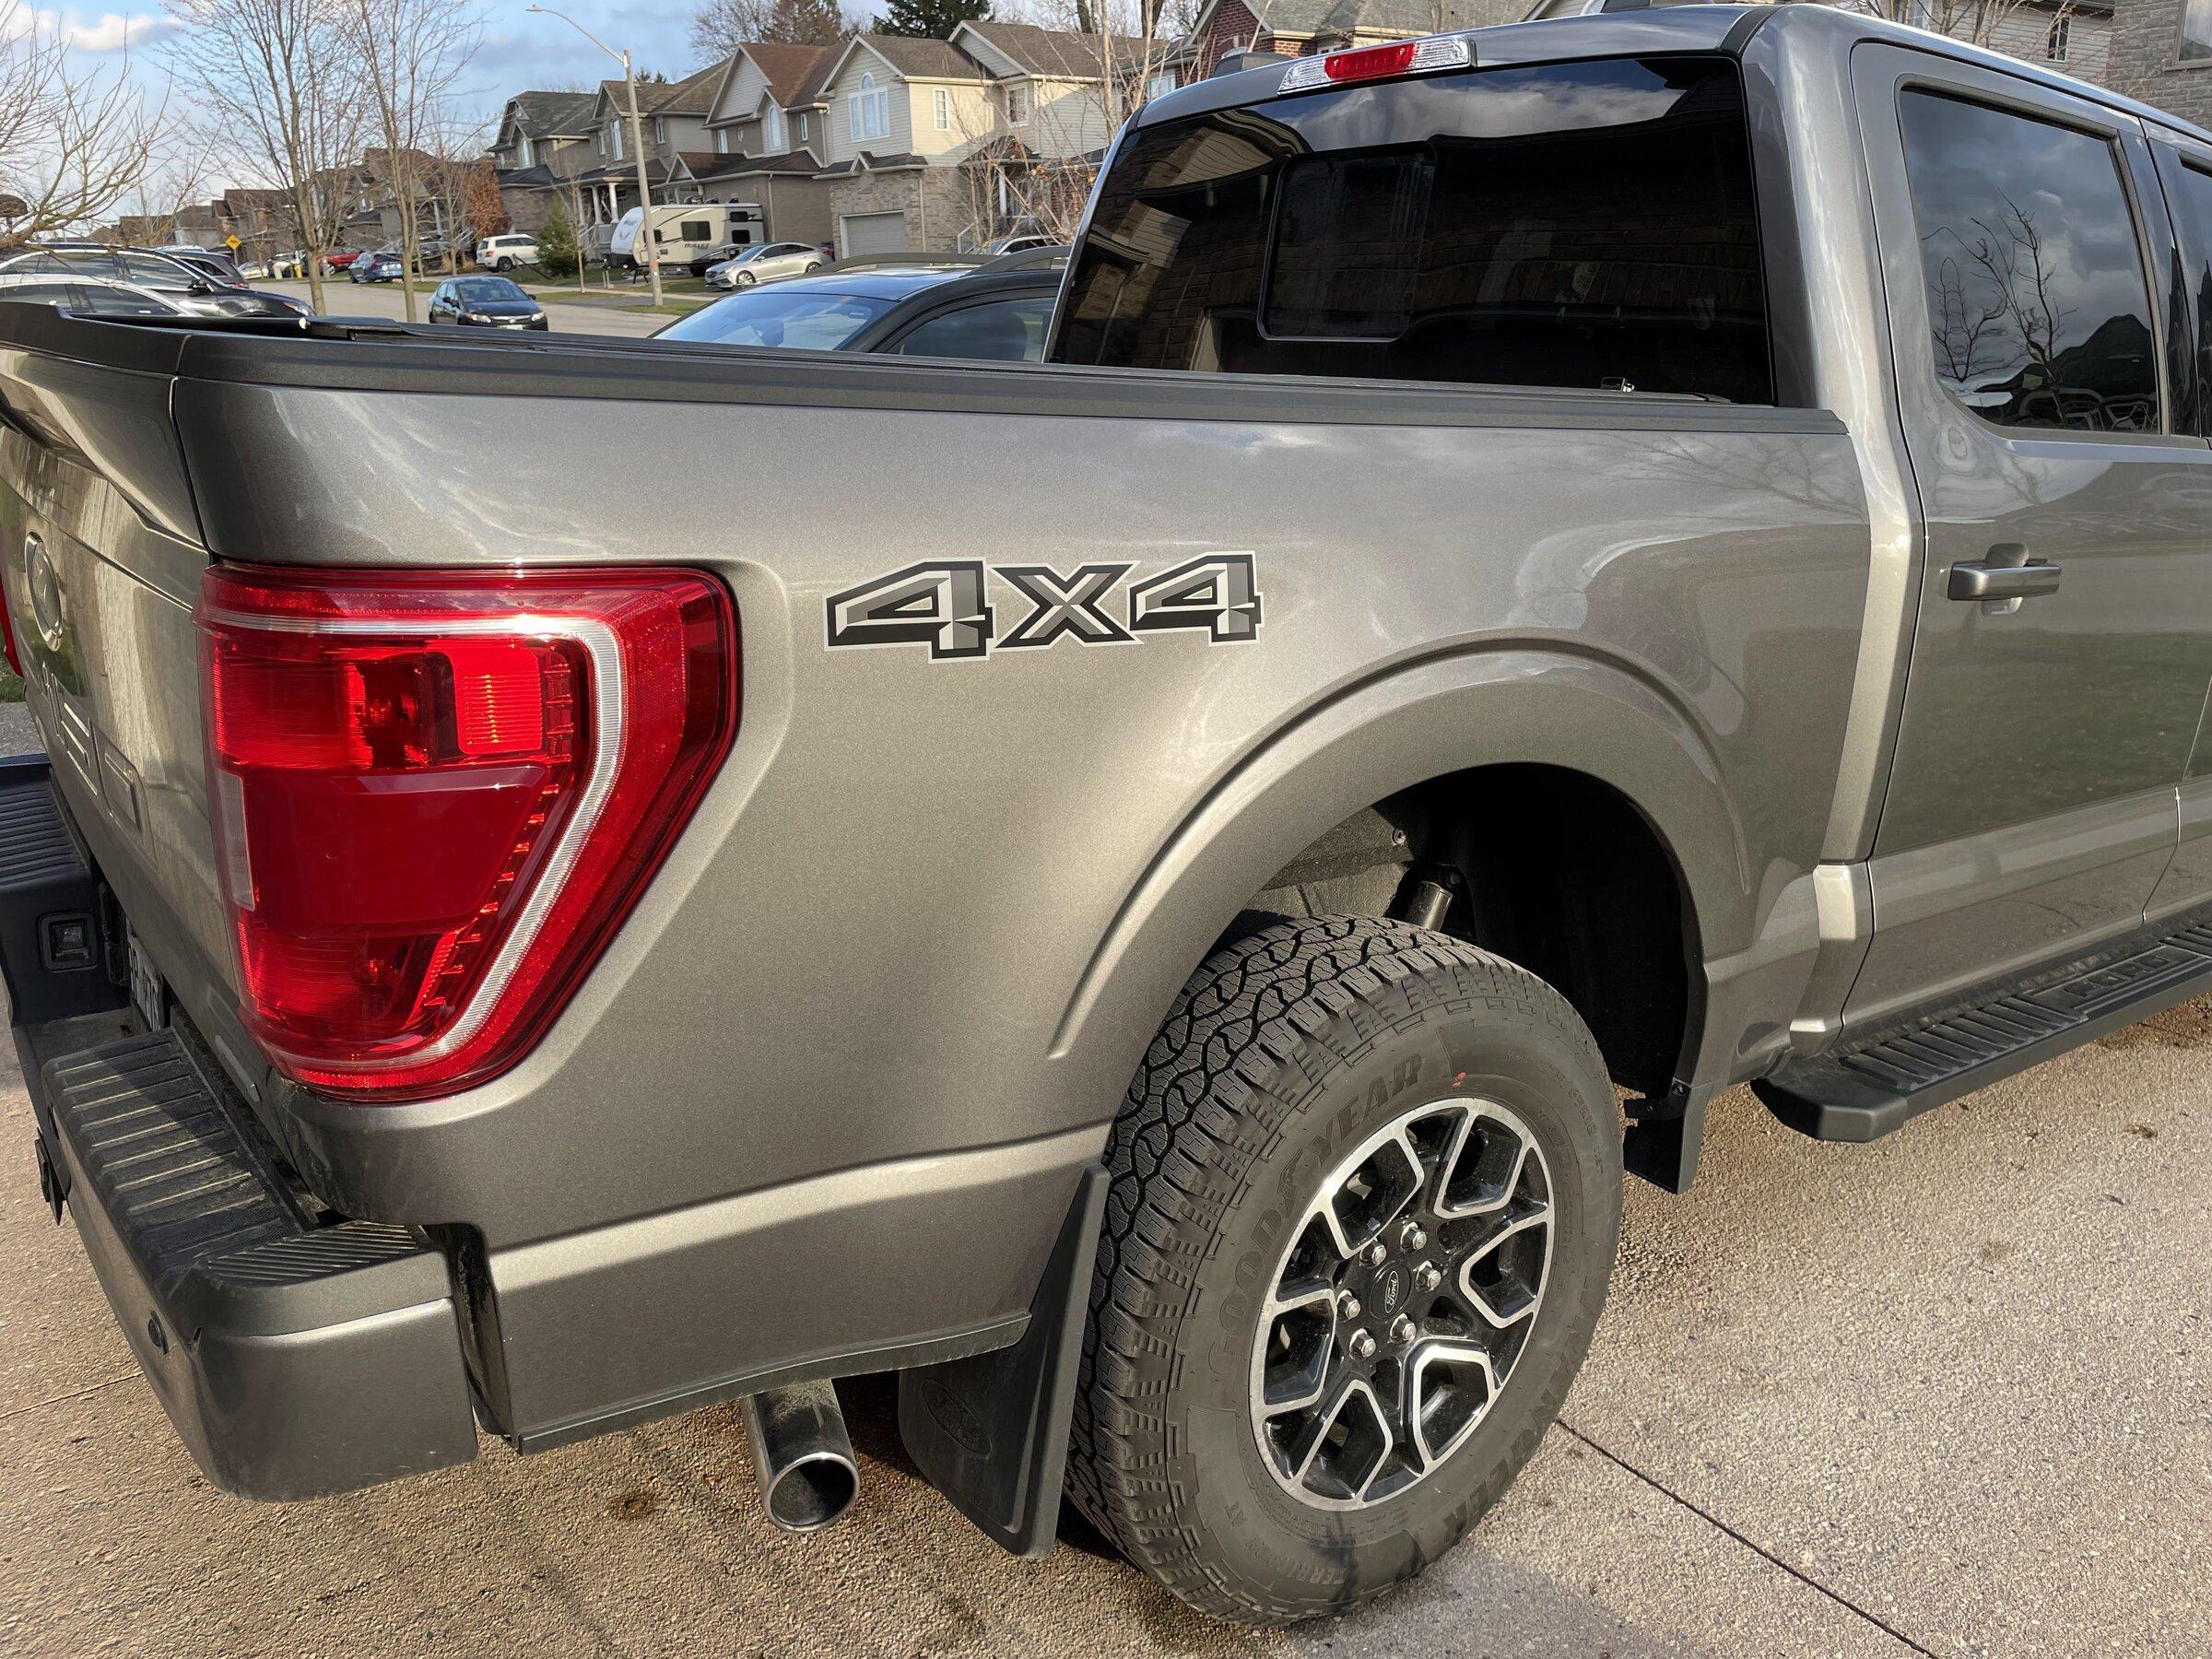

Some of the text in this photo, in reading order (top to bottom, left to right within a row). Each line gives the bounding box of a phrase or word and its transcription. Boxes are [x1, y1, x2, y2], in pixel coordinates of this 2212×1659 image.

[1207, 1053, 1423, 1376] GOODYEAR
[1386, 1278, 1397, 1306] Ford
[1442, 1273, 1602, 1543] WRANGLER
